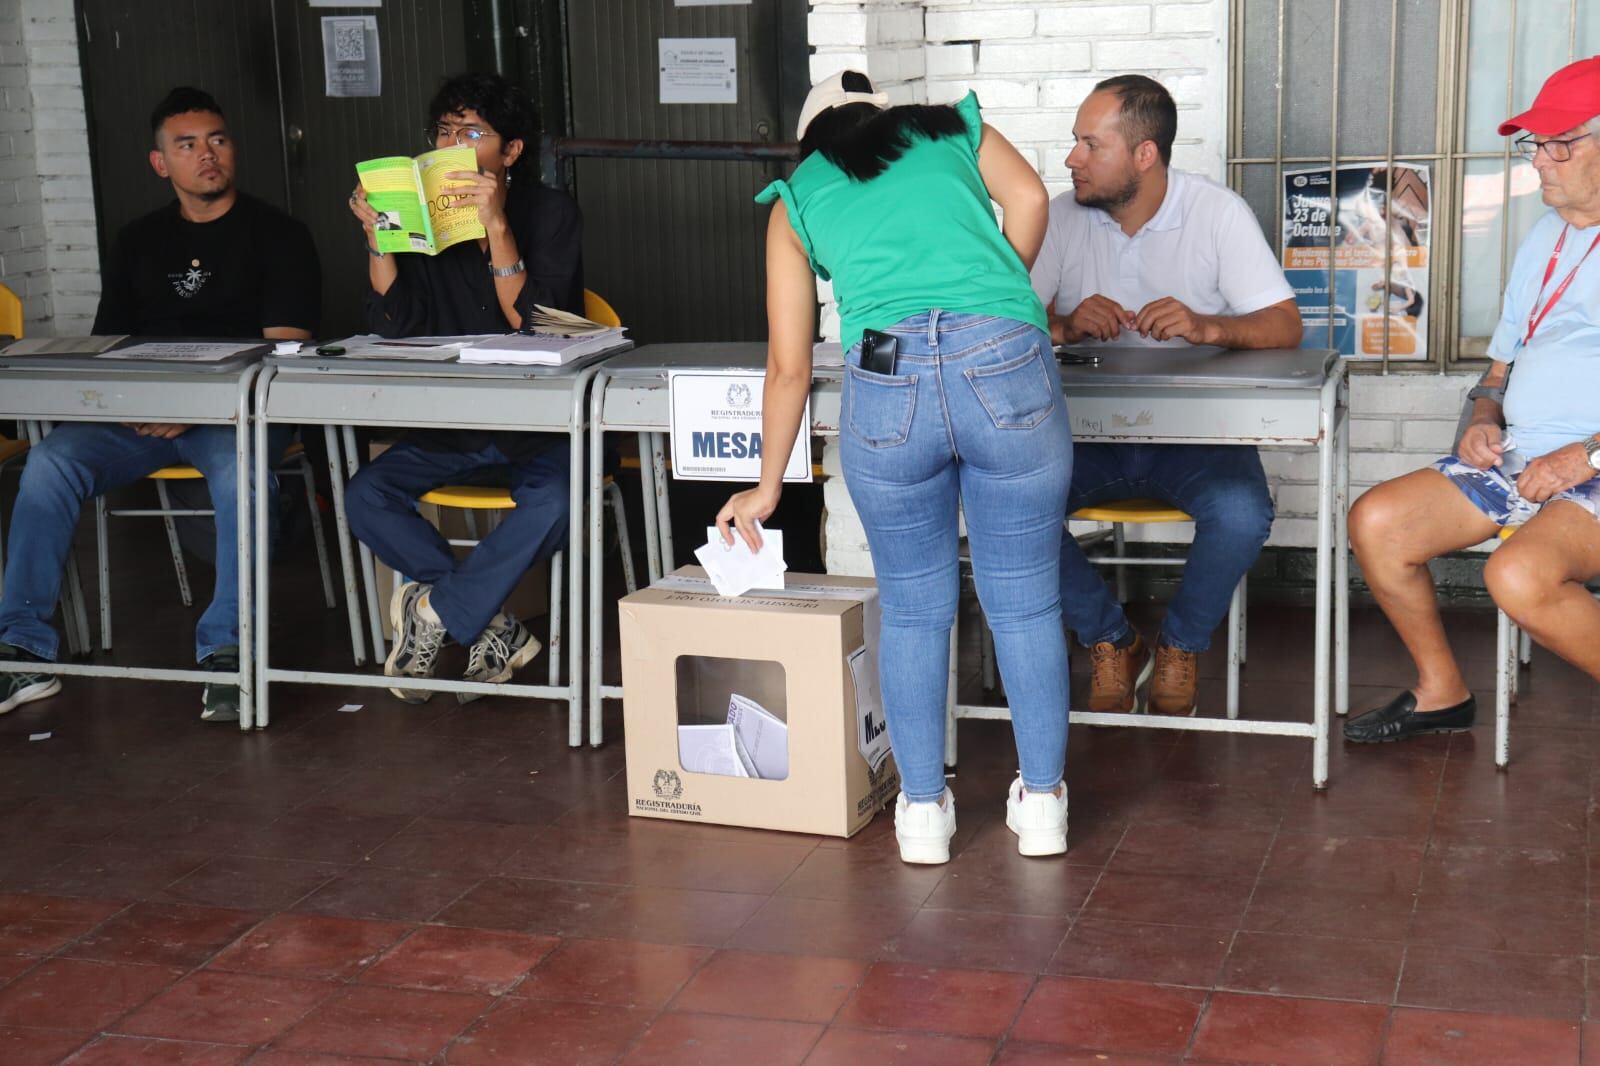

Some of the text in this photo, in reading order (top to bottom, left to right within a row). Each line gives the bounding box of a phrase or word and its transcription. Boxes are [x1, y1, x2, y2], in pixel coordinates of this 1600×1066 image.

[1293, 208, 1327, 222] 23 de
[692, 431, 763, 459] MESA
[635, 798, 702, 811] REGISTRADURÍA
